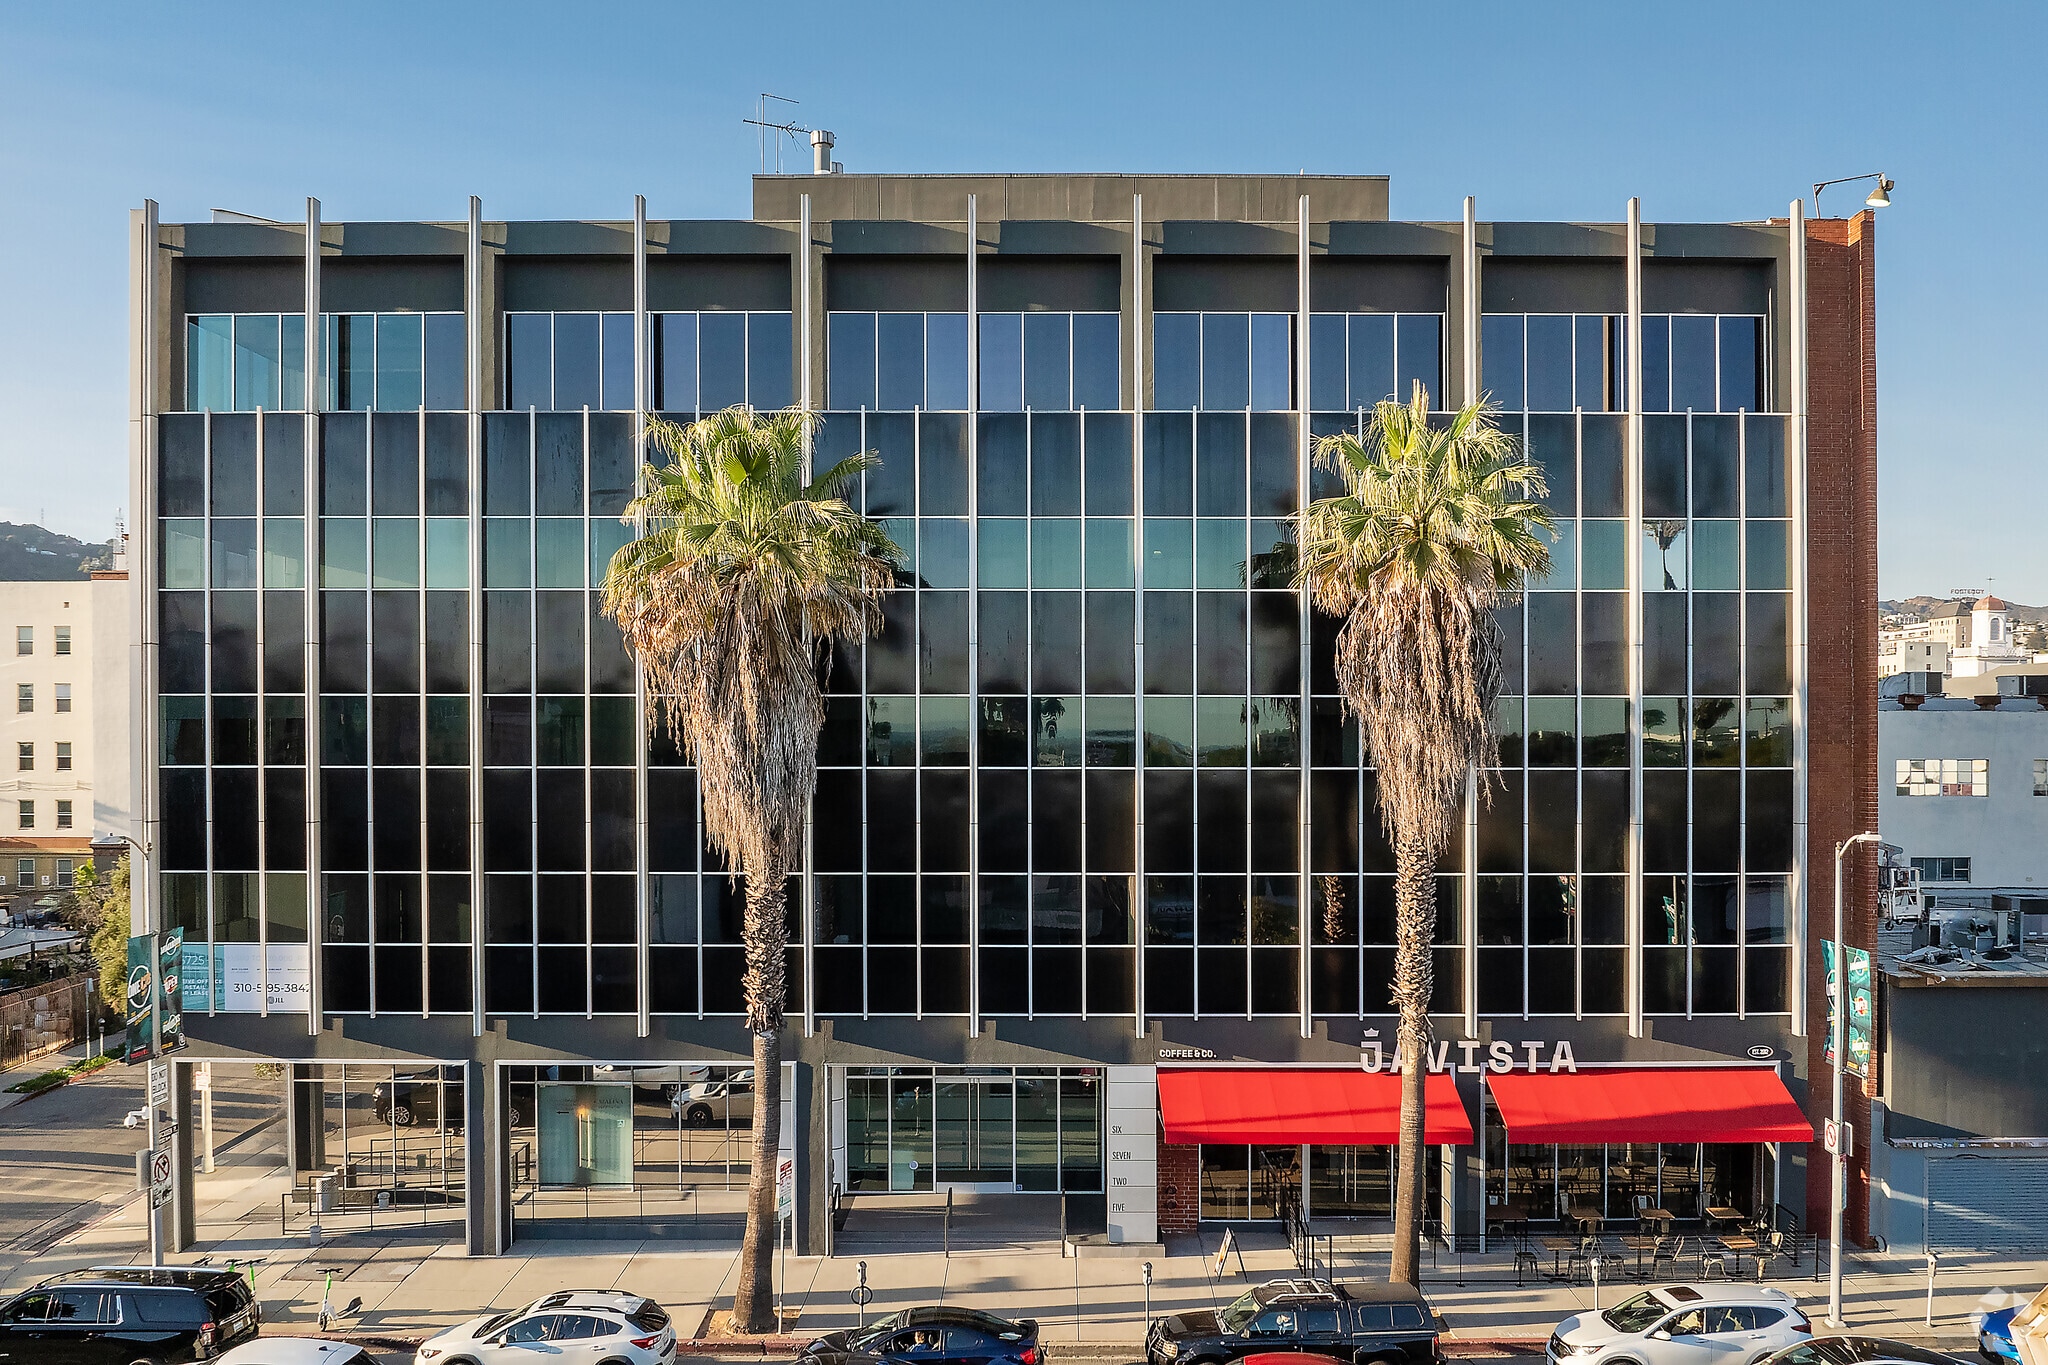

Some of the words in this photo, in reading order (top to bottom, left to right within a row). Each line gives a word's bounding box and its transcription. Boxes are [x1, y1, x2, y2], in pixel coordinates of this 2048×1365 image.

[1159, 1049, 1194, 1058] COFFEE
[1111, 1125, 1122, 1134] SIX
[1112, 1151, 1131, 1160] SEVEN
[1112, 1177, 1127, 1186] TWO
[1112, 1203, 1125, 1212] FIVE
